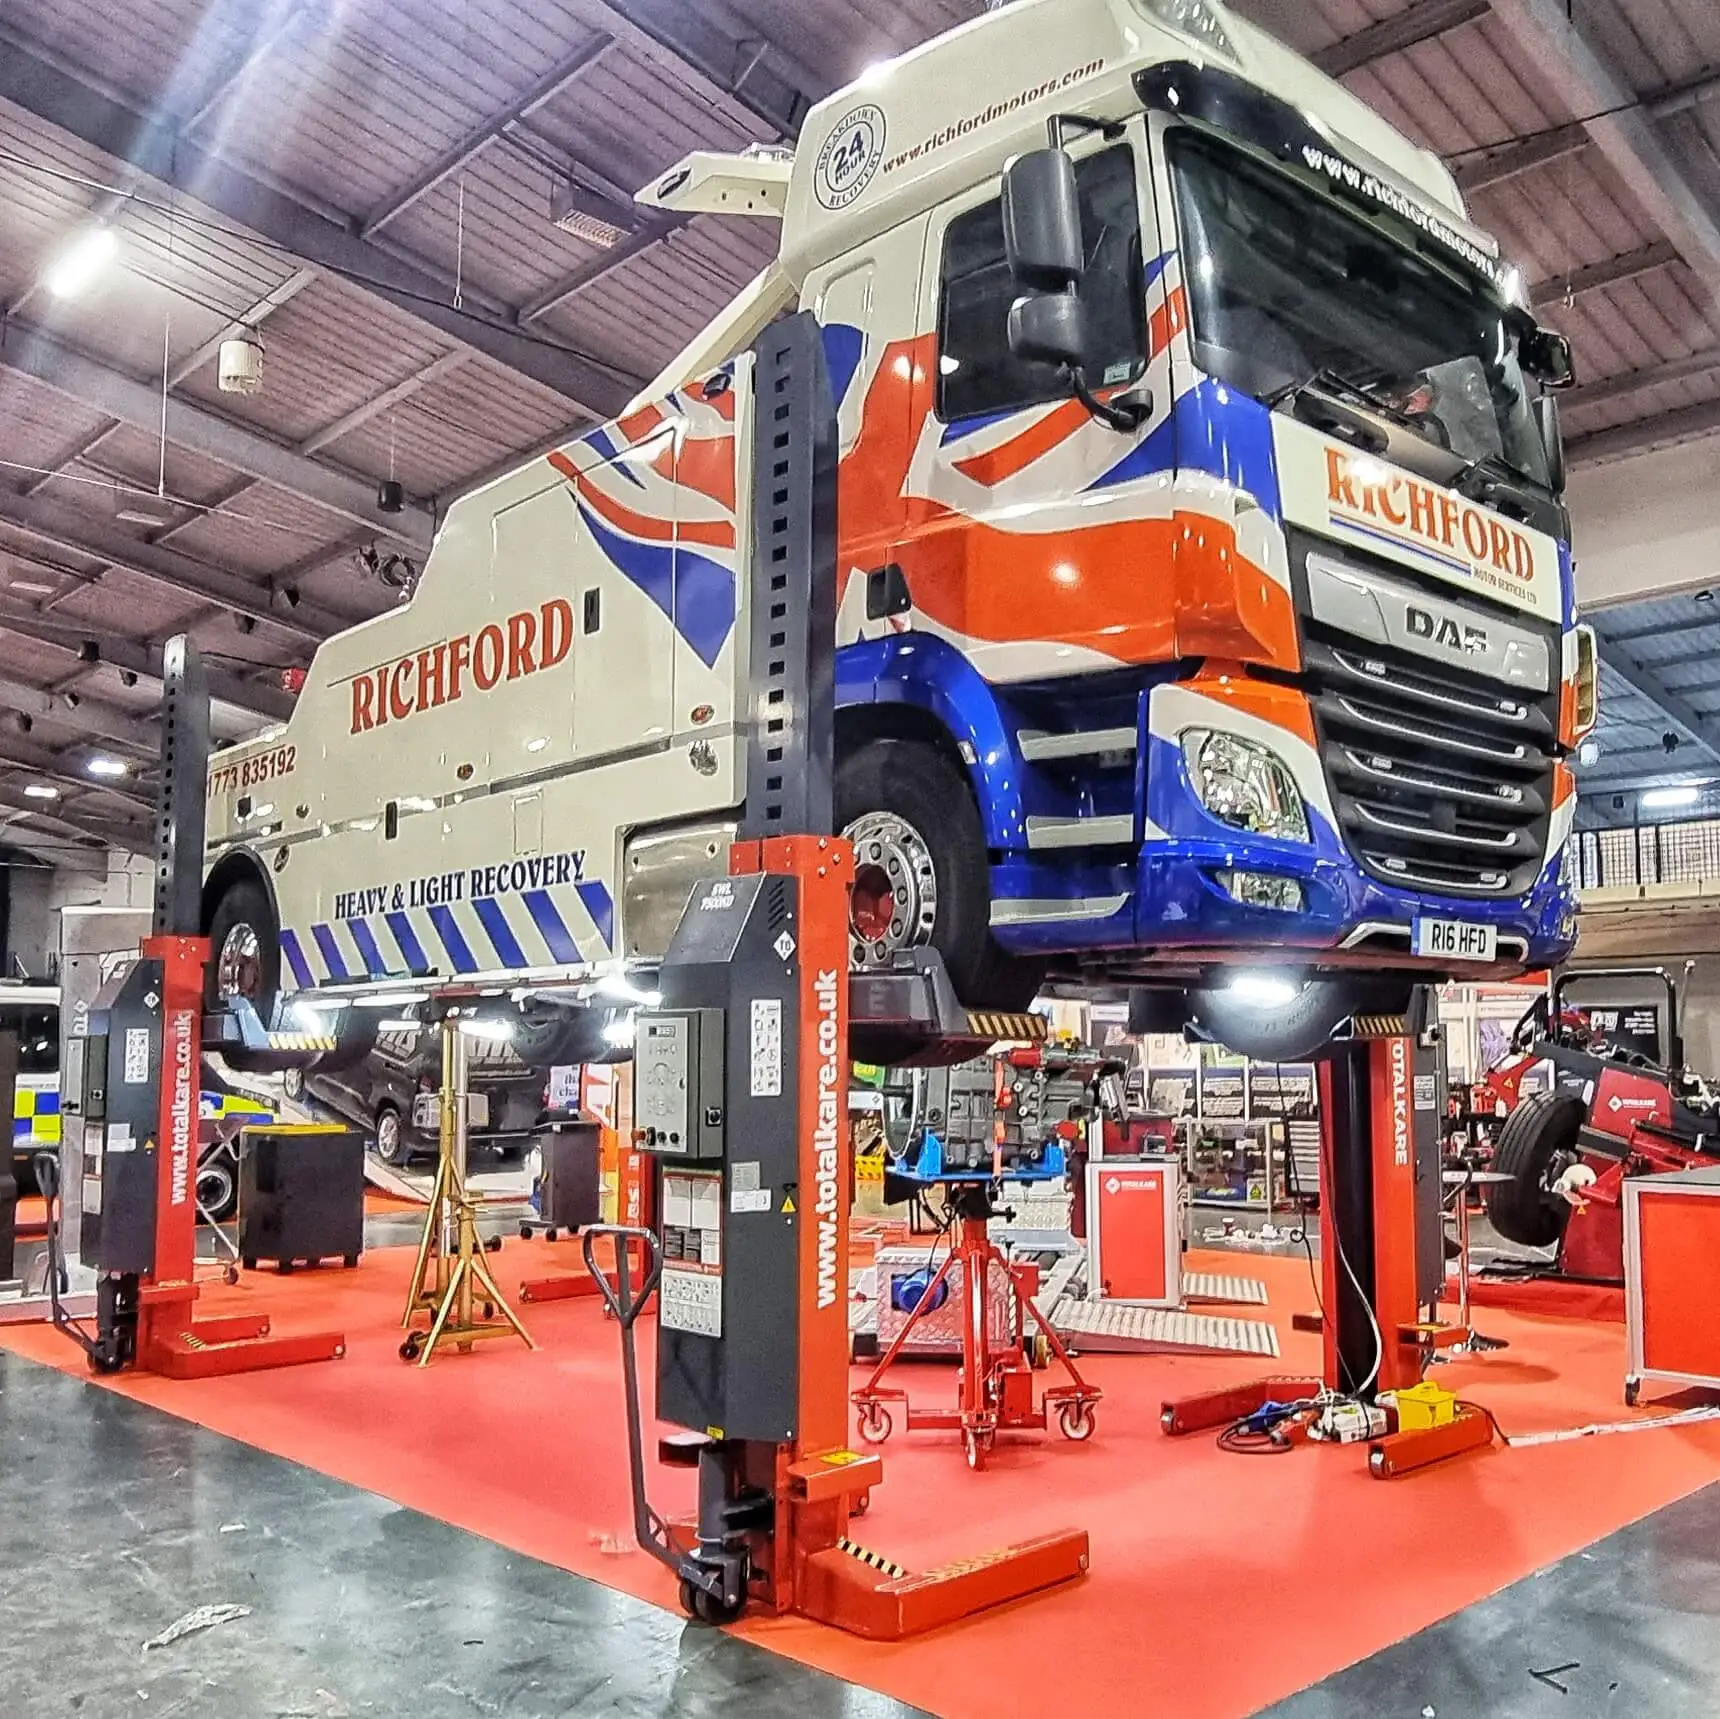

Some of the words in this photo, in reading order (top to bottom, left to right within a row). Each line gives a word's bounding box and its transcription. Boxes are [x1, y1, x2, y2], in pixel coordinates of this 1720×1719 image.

[882, 57, 1105, 175] www.richfordmotors.com
[833, 130, 865, 174] 24
[834, 150, 866, 185] HOUR
[1405, 605, 1488, 655] DAF
[350, 598, 573, 736] RICHFORD
[242, 745, 297, 788] 835192
[334, 885, 388, 921] HEAVY
[391, 882, 405, 911] &
[409, 870, 466, 908] LIGHT
[470, 849, 586, 898] RECOVERY
[1458, 927, 1487, 954] HFD
[171, 1009, 195, 1206] www.totalkare.co.uk
[813, 968, 839, 1309] www.totalkare.co.uk
